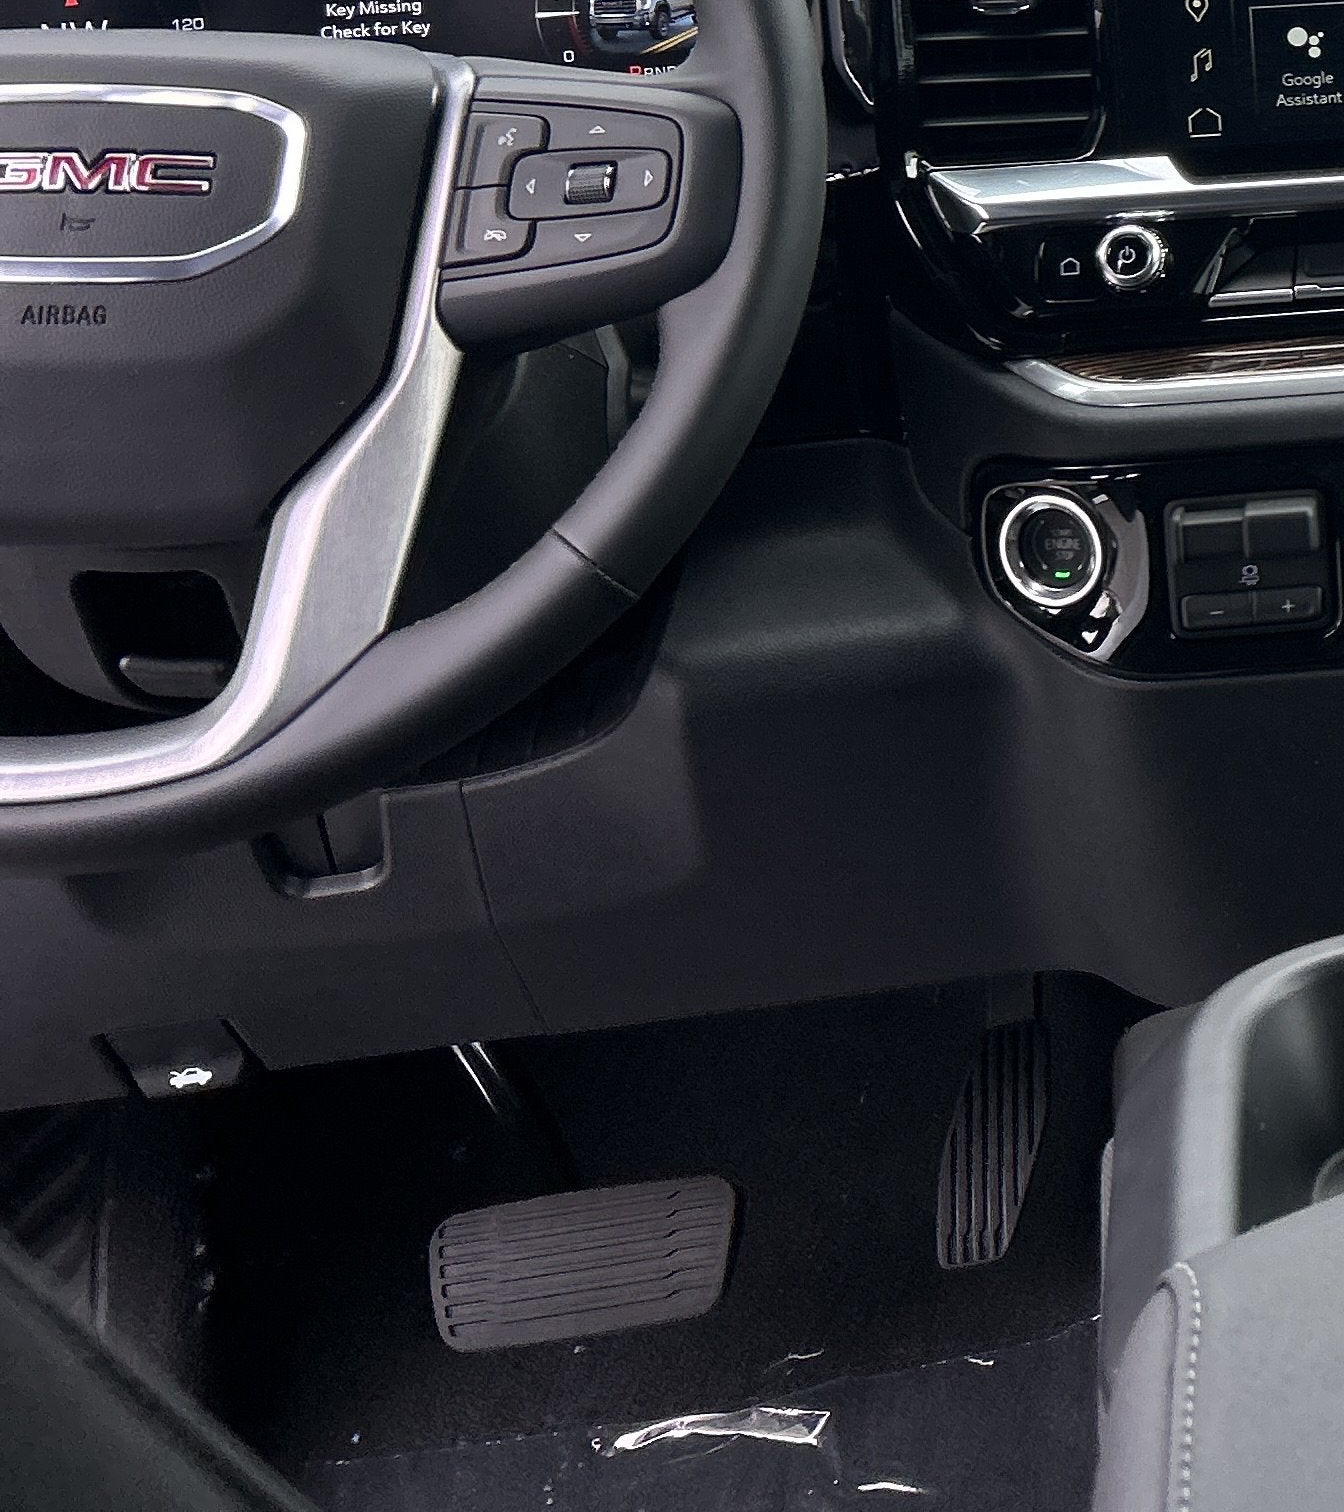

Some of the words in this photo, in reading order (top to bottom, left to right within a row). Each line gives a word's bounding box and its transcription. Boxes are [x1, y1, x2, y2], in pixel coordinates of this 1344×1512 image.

[325, 3, 355, 19] Key
[359, 0, 422, 16] Missing
[172, 17, 205, 31] 120
[320, 23, 371, 38] Check
[374, 22, 399, 36] for
[401, 20, 431, 37] Key
[563, 50, 575, 63] 0
[1282, 71, 1334, 88] Google
[1276, 92, 1343, 107] Assistant
[0, 151, 215, 194] GMC
[20, 304, 107, 326] AIRBAG
